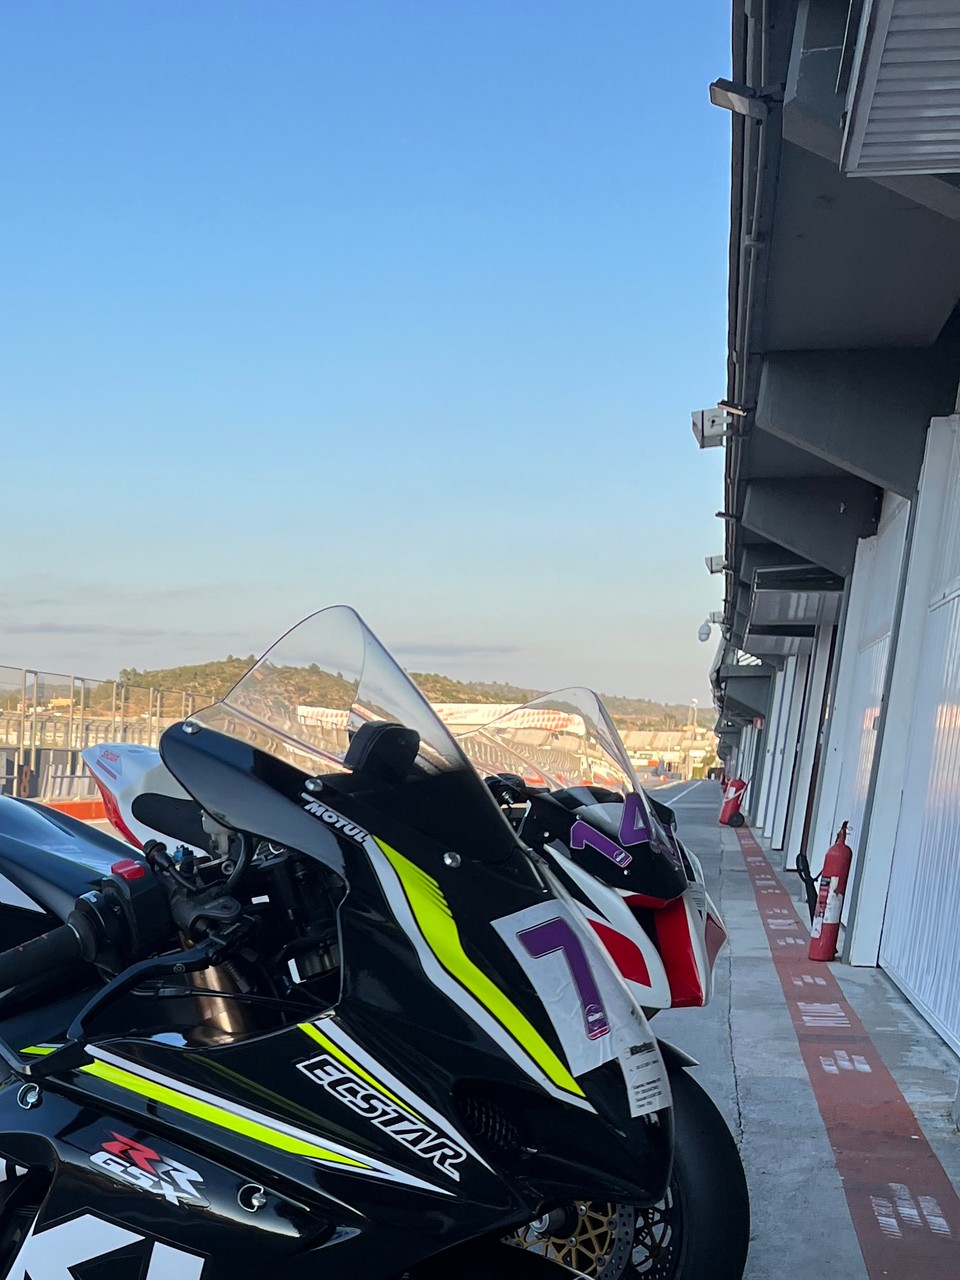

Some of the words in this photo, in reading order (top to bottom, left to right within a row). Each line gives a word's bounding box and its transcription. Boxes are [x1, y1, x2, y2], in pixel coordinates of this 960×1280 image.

[303, 800, 367, 843] MOTUL
[515, 915, 611, 1041] 7
[295, 1053, 468, 1182] ECSTAR
